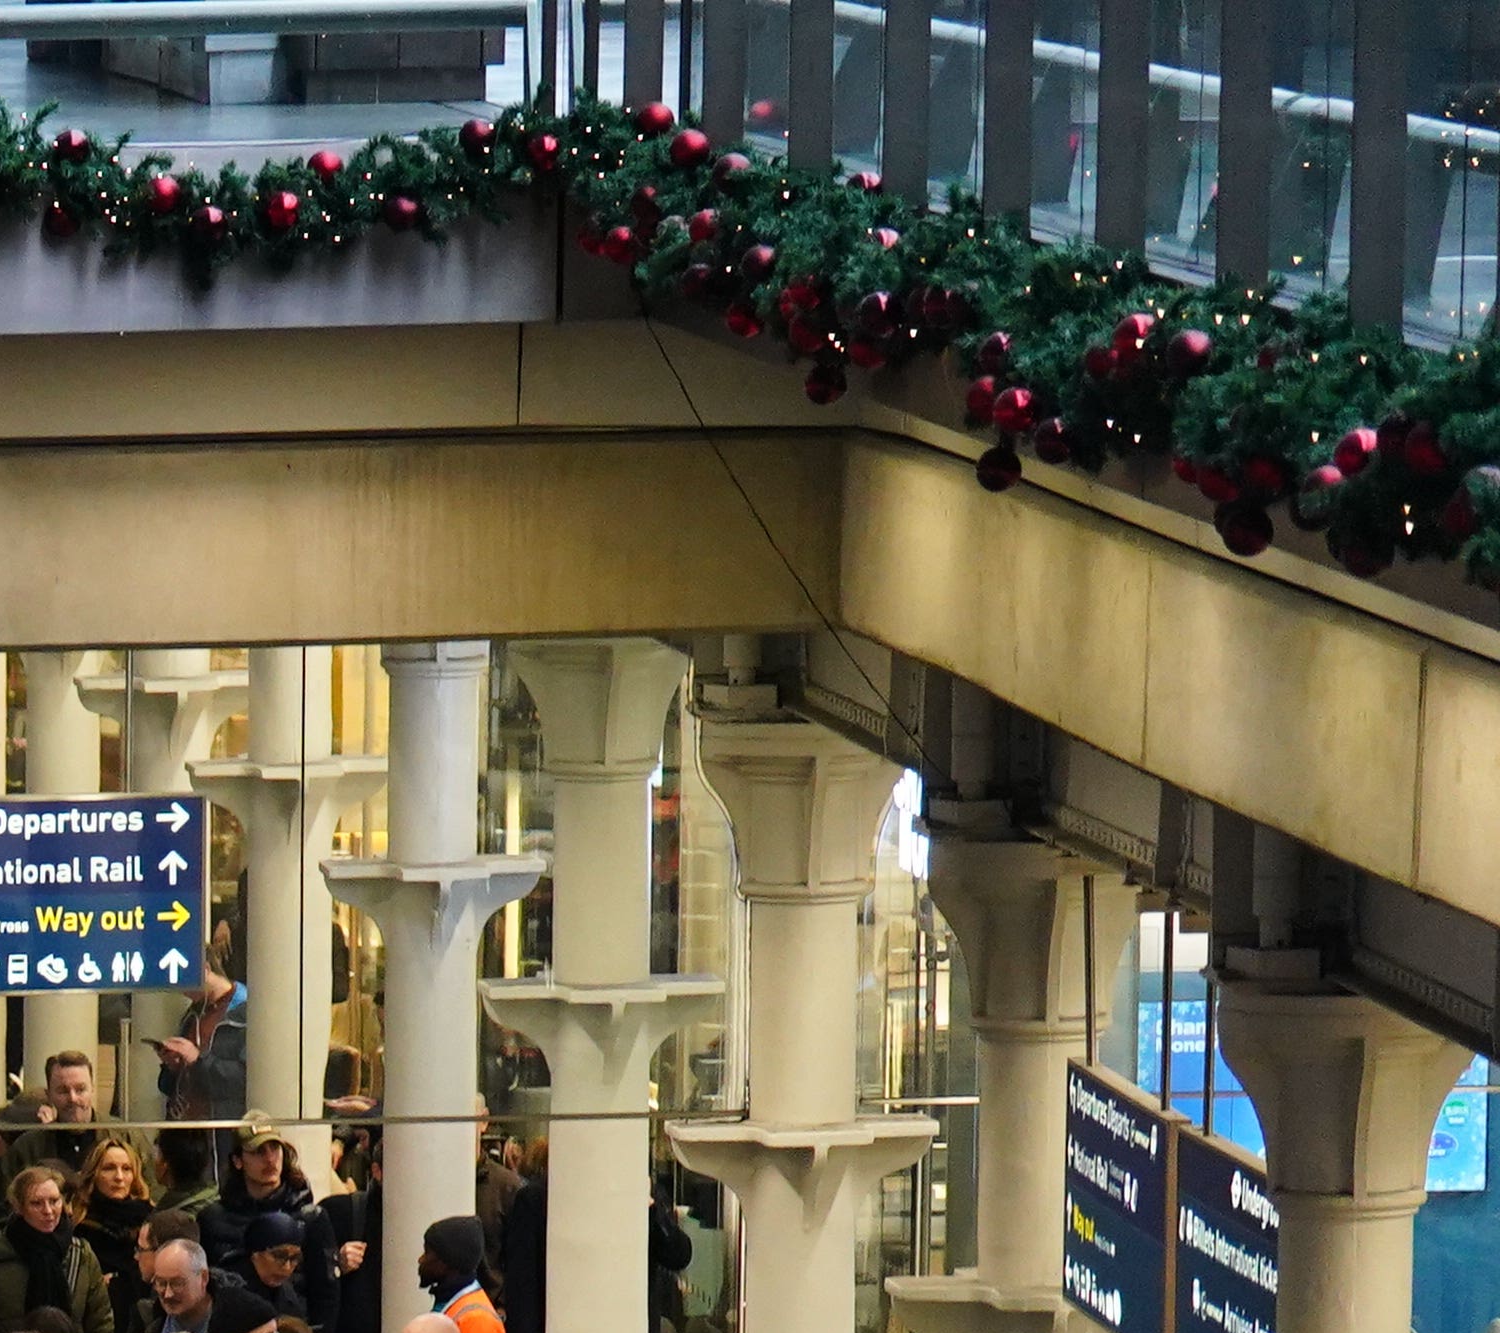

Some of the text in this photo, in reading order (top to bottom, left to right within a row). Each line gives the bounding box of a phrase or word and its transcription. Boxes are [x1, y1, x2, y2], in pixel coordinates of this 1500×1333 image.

[90, 856, 143, 882] Rail
[36, 906, 144, 937] Way out
